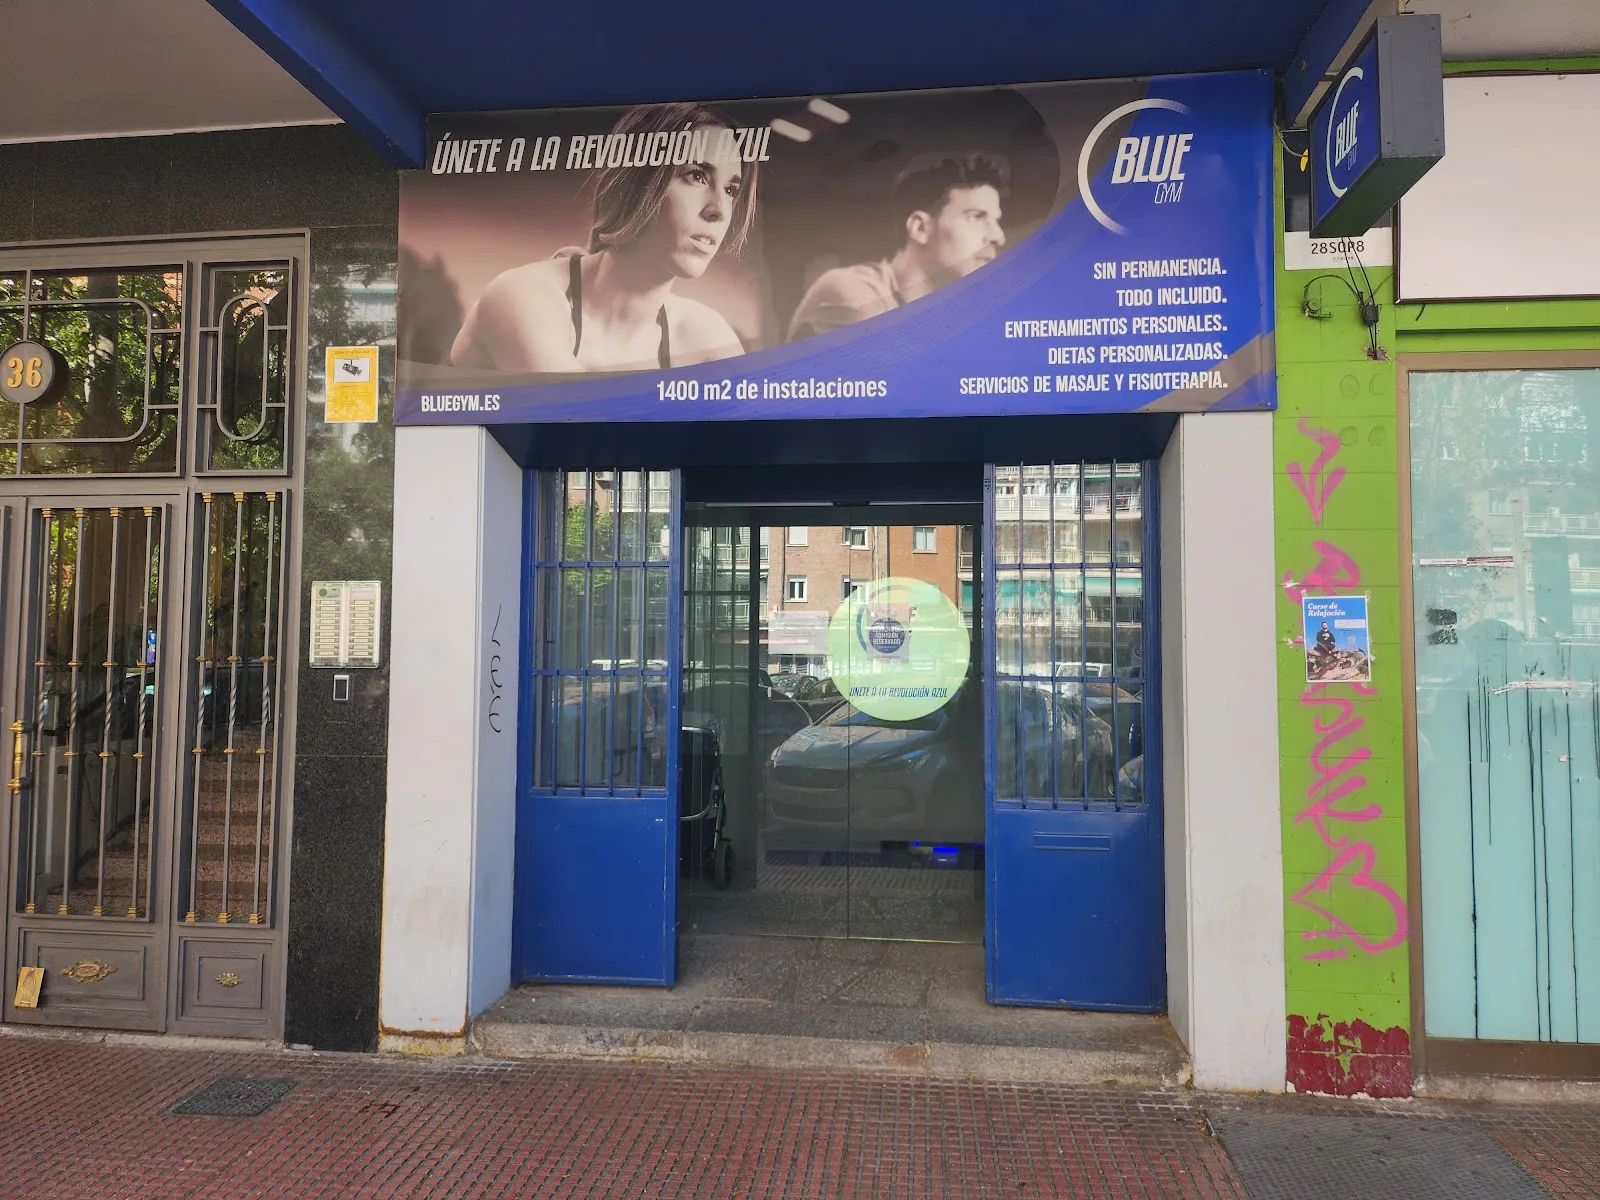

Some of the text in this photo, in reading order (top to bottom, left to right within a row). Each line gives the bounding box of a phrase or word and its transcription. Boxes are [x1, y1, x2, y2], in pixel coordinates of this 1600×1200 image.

[1335, 99, 1360, 168] BLUE
[431, 122, 772, 175] ÚNETE A LA REVOLUCIÓN AZUL
[1111, 133, 1194, 184] BLUE
[1154, 182, 1184, 204] GYM
[1093, 258, 1227, 280] SIN PERMANENCIA.
[1116, 286, 1227, 307] TODO INCLUIDO.
[1005, 314, 1228, 339] ENTRENAMIENTOS PERSONALES.
[1048, 342, 1228, 365] DIETAS PERSONALIZADAS.
[7, 356, 42, 389] 36
[959, 370, 1228, 395] SERVICIOS DE MASAJE Y FISIOTERAPIA.
[656, 376, 888, 401] 1400 m2 de instalaciones
[421, 394, 501, 412] BLUEGYM.ES
[1307, 609, 1346, 618] Relajación
[1308, 602, 1328, 610] Curso
[875, 631, 899, 639] ADMISIÓN
[871, 686, 878, 697] A
[879, 686, 888, 697] LA
[889, 685, 930, 698] REVOLUCIÓN
[931, 687, 948, 698] AZUL
